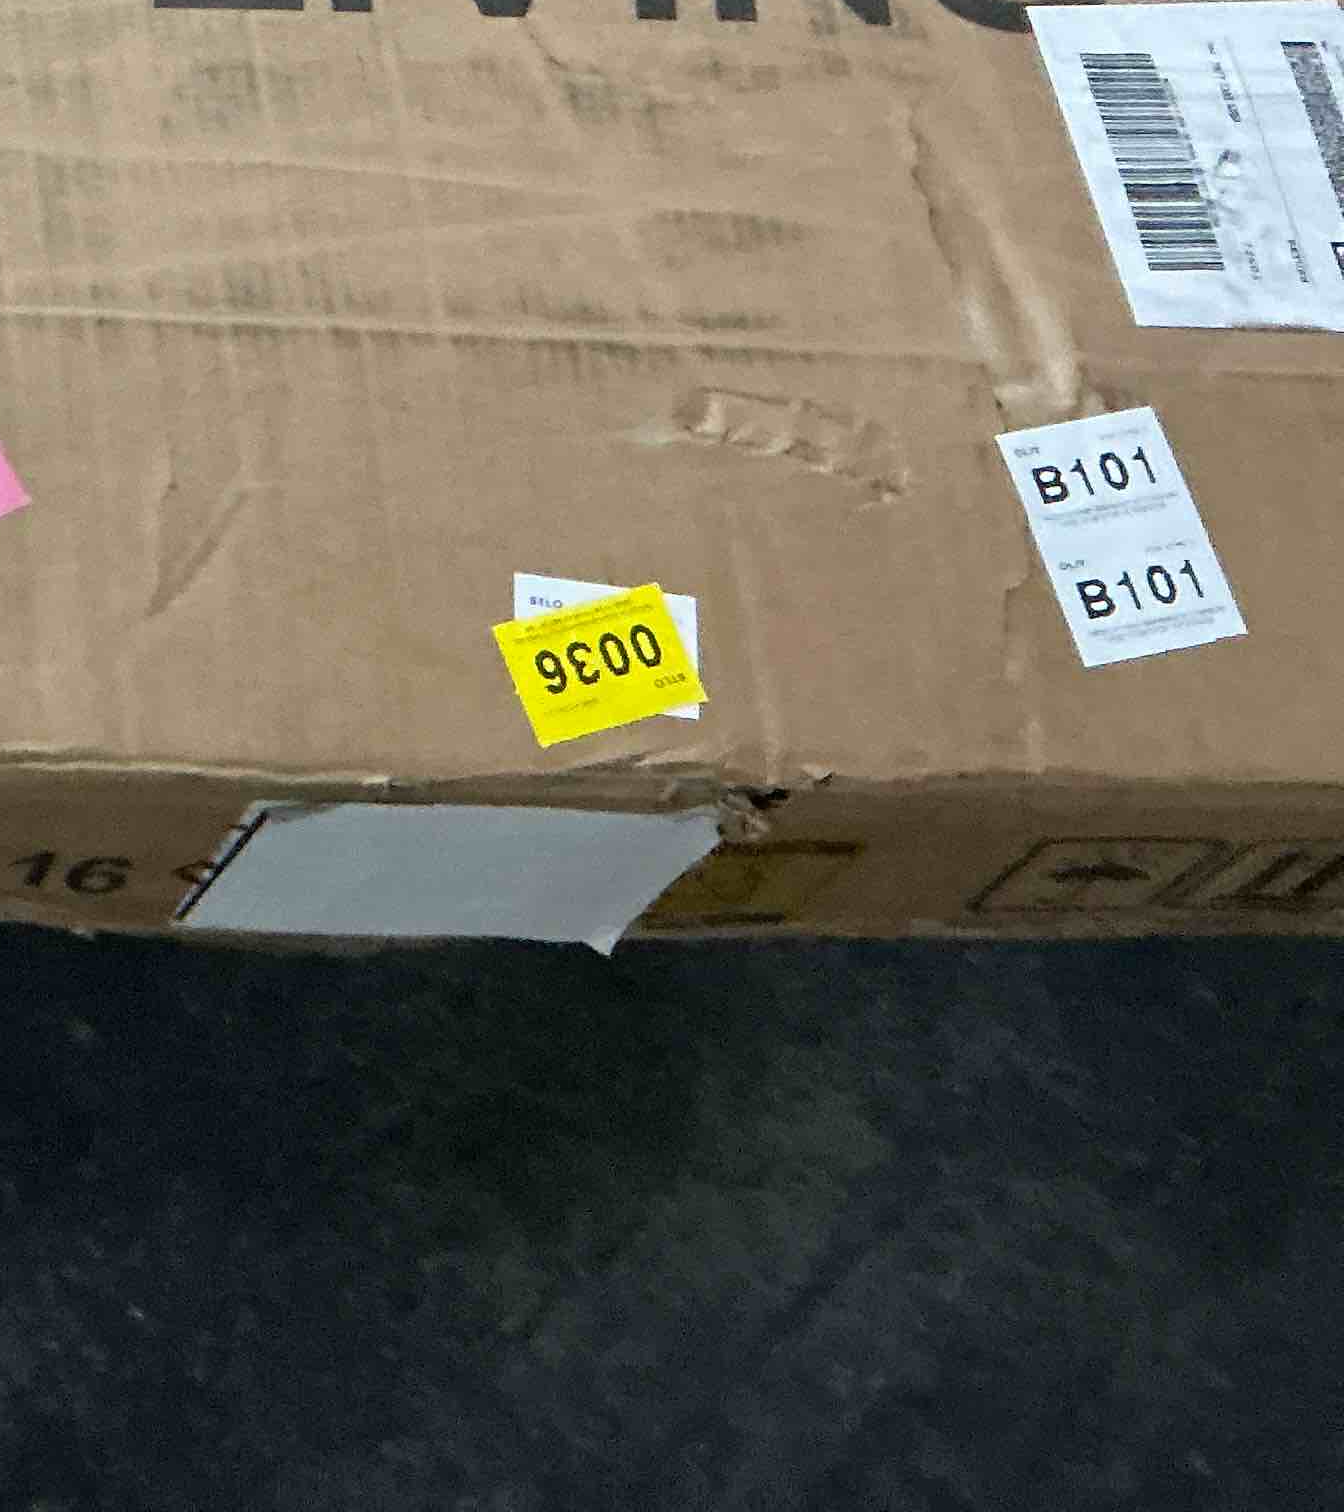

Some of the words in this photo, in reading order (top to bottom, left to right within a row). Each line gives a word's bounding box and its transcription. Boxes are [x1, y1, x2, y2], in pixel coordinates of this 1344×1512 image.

[1031, 445, 1157, 505] B101
[1075, 558, 1205, 620] B101
[534, 622, 662, 695] 0036
